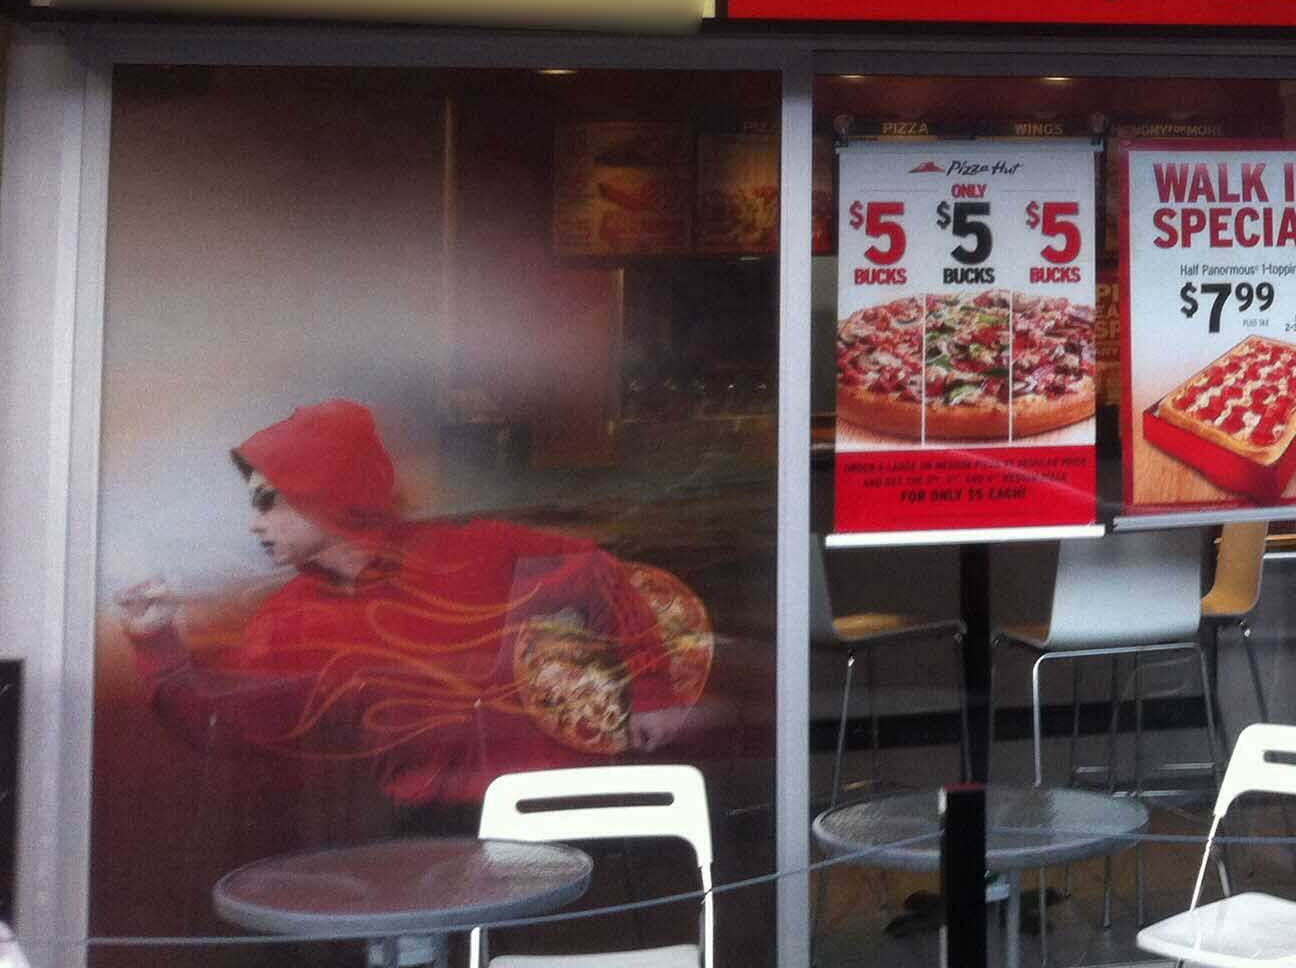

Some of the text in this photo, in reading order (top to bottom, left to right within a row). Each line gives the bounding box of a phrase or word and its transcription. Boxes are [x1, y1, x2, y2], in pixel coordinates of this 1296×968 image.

[882, 122, 929, 135] PIZZA
[1015, 123, 1063, 136] WINGS
[946, 160, 1023, 177] Pizza Hut
[1153, 162, 1269, 203] WALK
[951, 184, 988, 199] ONLY
[849, 200, 1082, 265] $5 $5 $5
[854, 267, 1081, 284] BUCKS BUCKS BUCKS
[1180, 264, 1199, 276] Half
